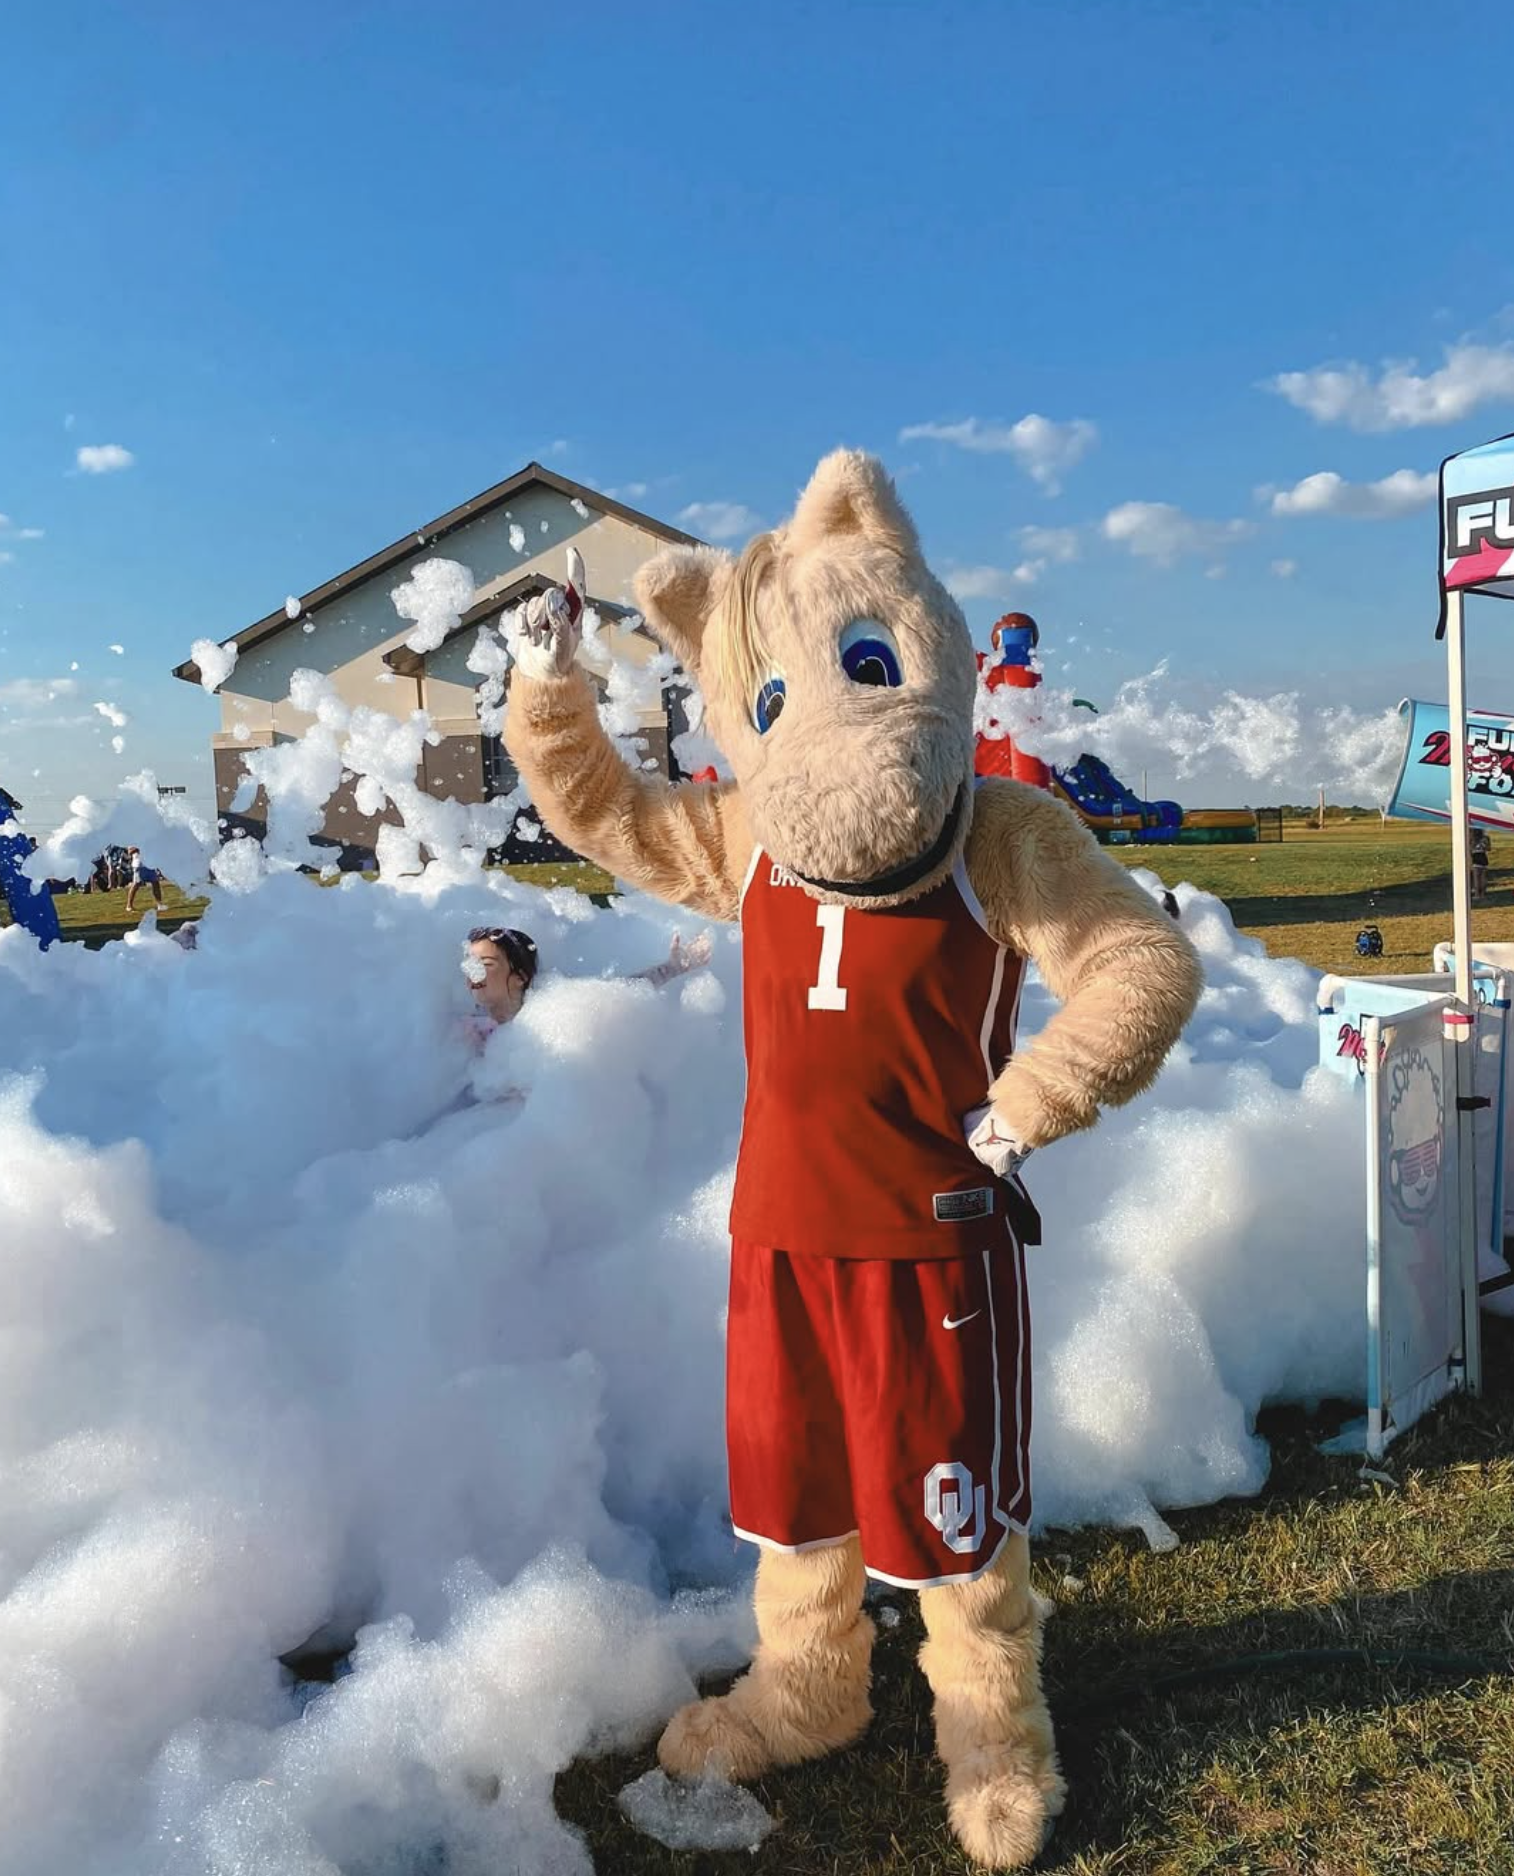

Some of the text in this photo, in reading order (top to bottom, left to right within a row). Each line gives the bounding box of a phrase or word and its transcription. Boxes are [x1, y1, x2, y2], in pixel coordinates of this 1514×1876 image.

[1467, 727, 1514, 751] FU
[1467, 771, 1514, 794] FO
[808, 904, 847, 1011] 1
[924, 1461, 986, 1553] OU
